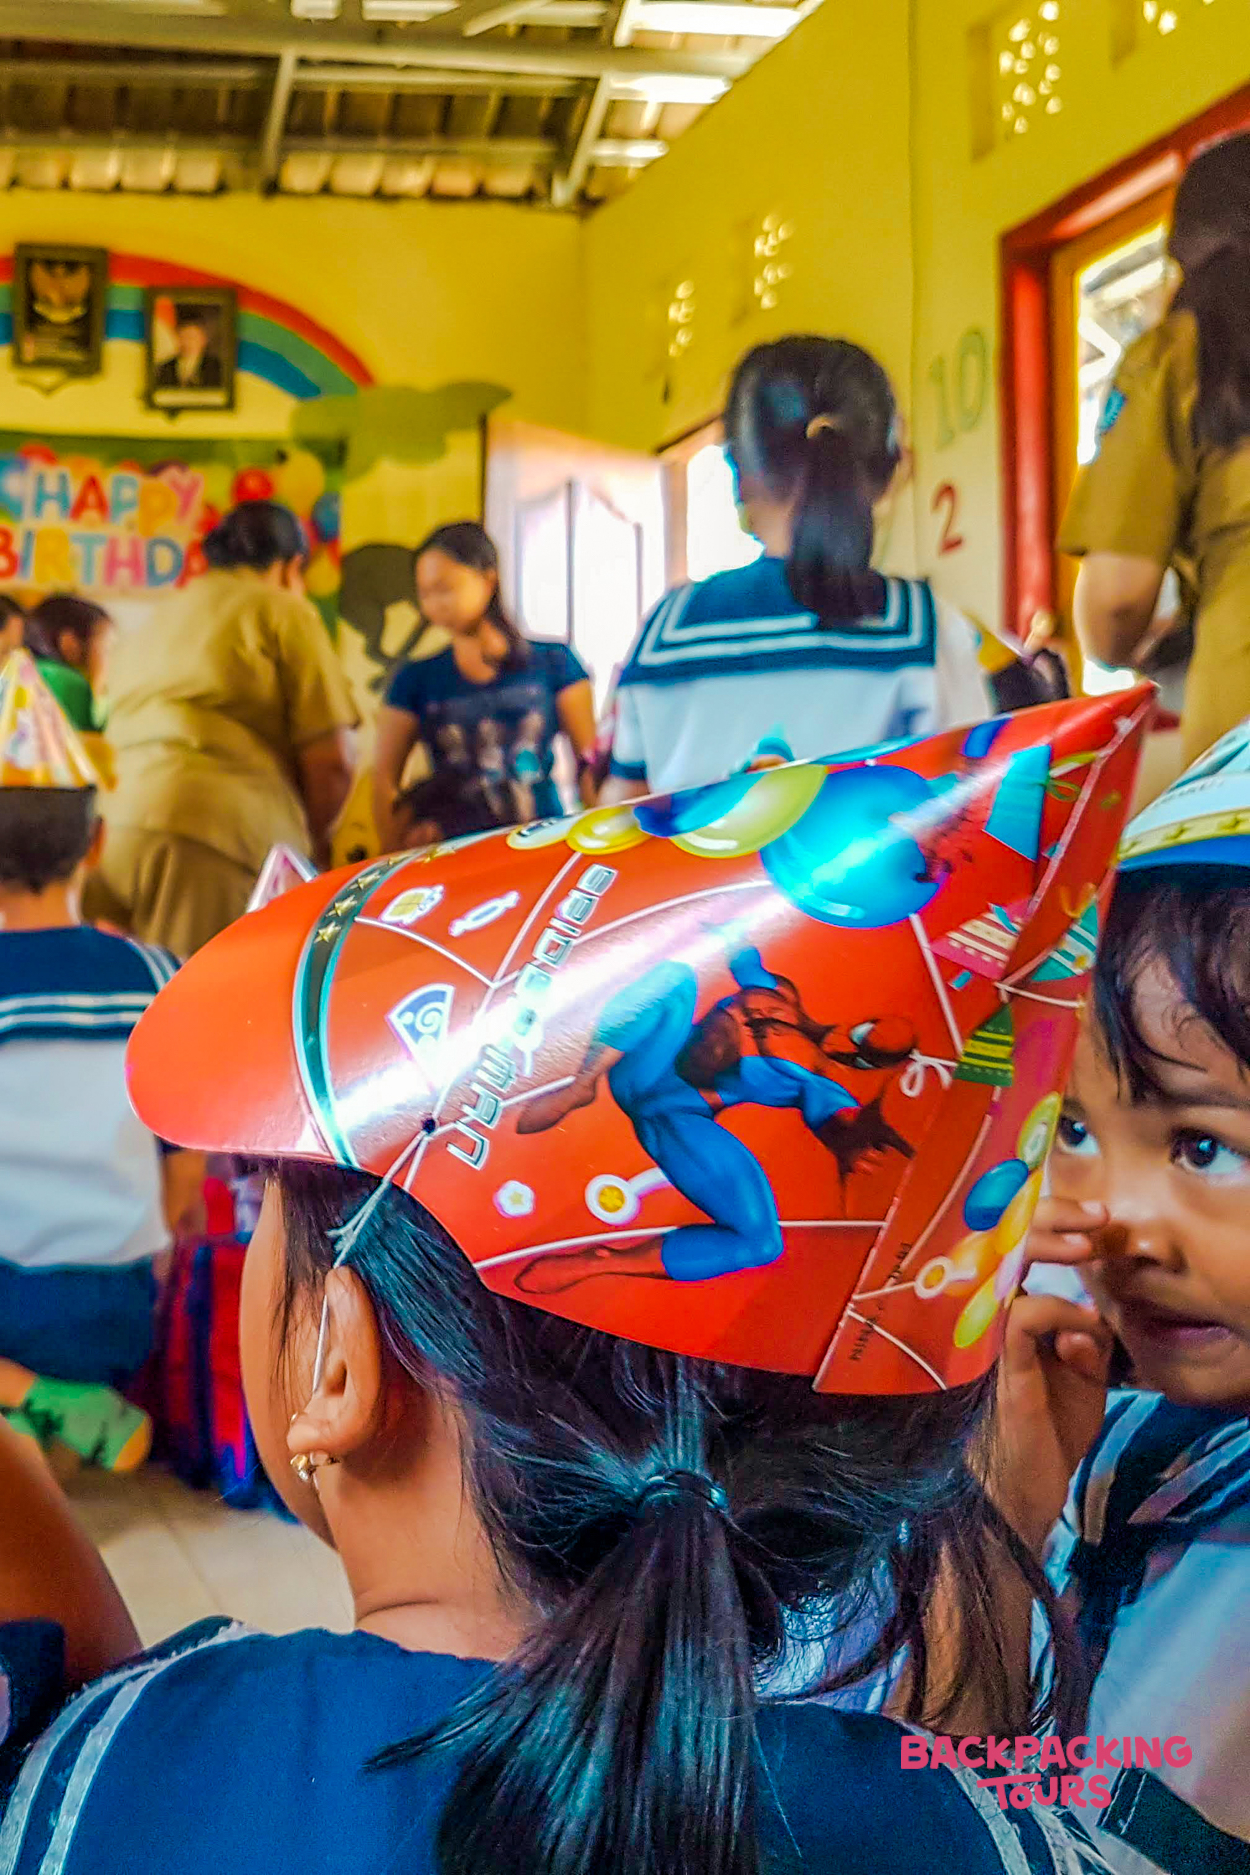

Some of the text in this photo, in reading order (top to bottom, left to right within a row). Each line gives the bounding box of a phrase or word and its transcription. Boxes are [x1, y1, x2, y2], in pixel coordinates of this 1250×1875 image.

[930, 328, 987, 447] 10
[33, 470, 203, 537] HAPPY
[931, 480, 964, 555] 2
